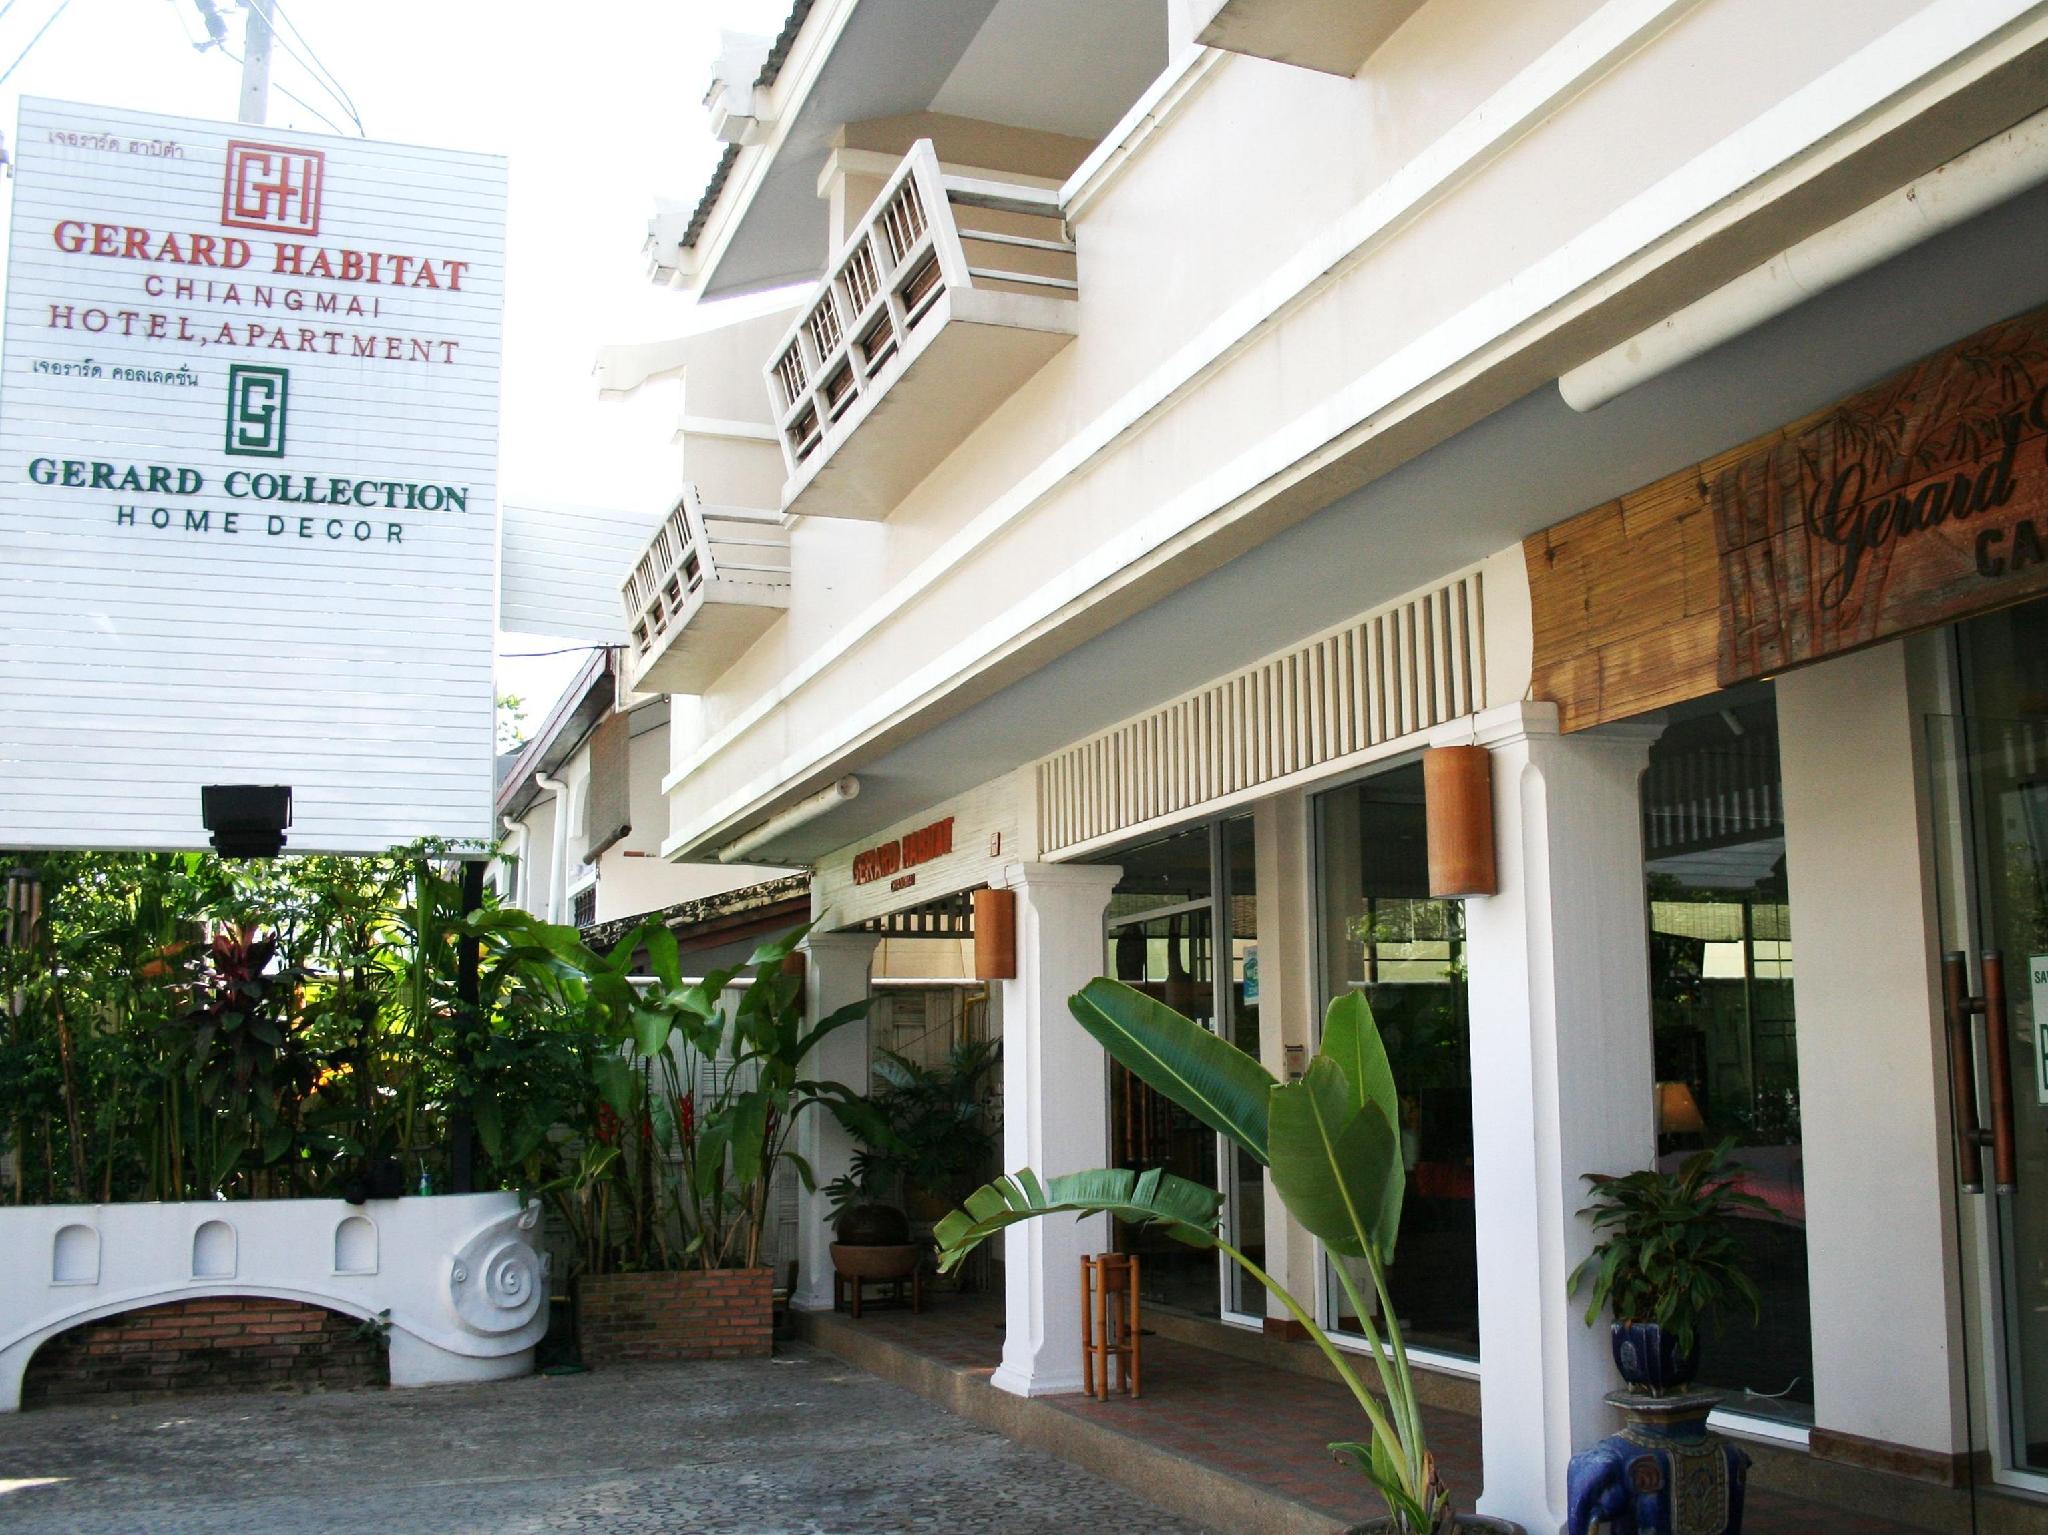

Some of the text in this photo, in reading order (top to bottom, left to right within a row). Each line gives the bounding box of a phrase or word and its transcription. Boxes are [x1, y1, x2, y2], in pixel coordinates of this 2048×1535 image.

[53, 219, 469, 291] GERARD HABITAT
[144, 274, 381, 318] CHIANGMAI
[28, 457, 468, 513] GERARD COLLECTION
[1805, 412, 2022, 609] Gerard
[117, 505, 404, 543] HOME DECOR
